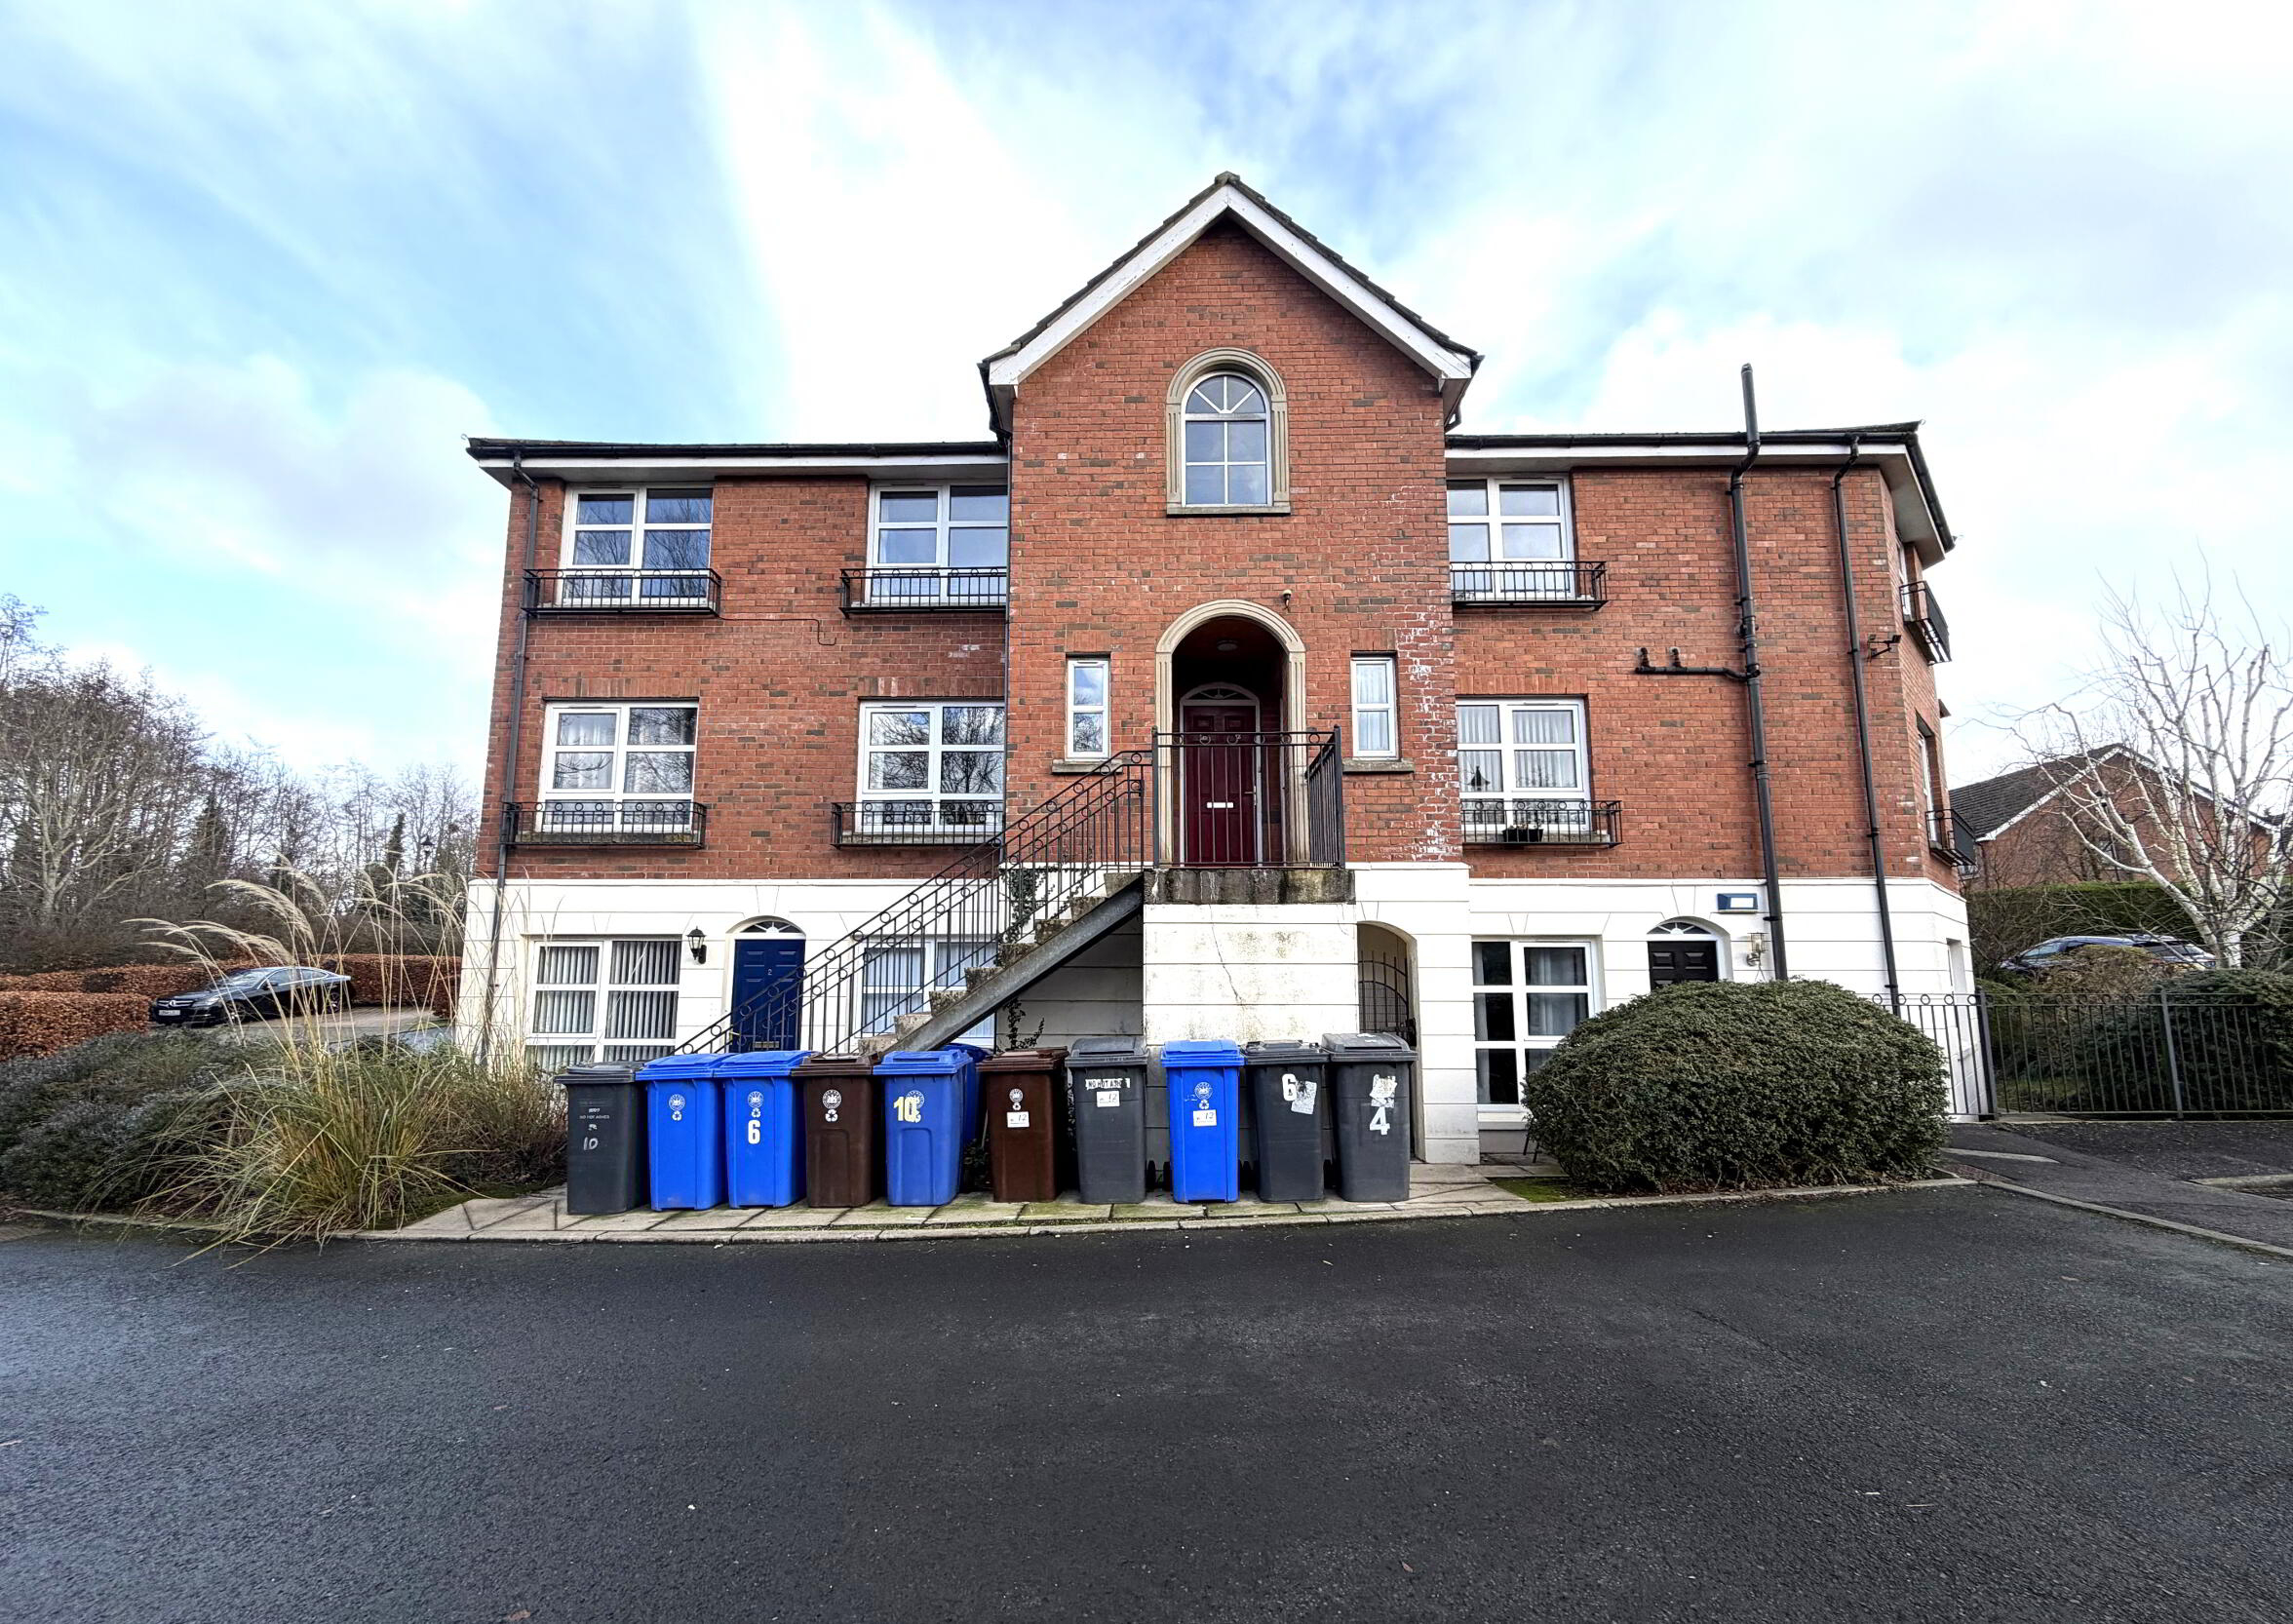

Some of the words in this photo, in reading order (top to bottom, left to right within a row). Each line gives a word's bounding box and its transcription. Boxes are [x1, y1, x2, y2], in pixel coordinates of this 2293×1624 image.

[1282, 1073, 1298, 1102] 6
[748, 1119, 760, 1144] 6
[1369, 1105, 1390, 1136] 4
[583, 1137, 599, 1151] 10
